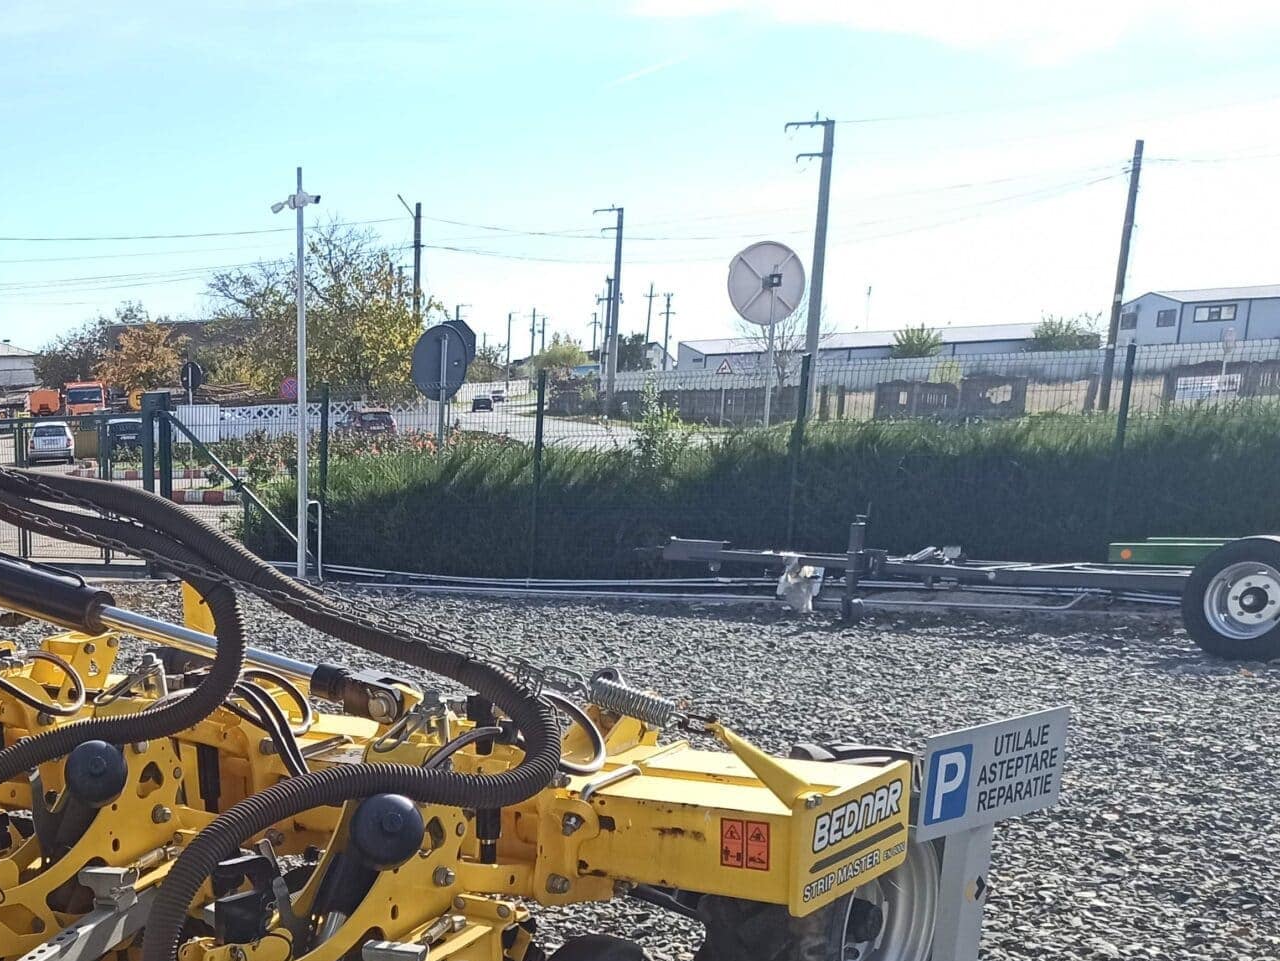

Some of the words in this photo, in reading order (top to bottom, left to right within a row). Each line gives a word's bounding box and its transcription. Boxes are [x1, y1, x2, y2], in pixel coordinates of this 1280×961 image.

[994, 724, 1050, 756] UTILAJE
[932, 752, 966, 820] P
[976, 747, 1059, 787] ASTEPTARE
[812, 779, 903, 854] BEDNAR
[976, 774, 1053, 812] REPARATIE
[803, 872, 835, 902] STRIP
[836, 848, 881, 885] MASTER
